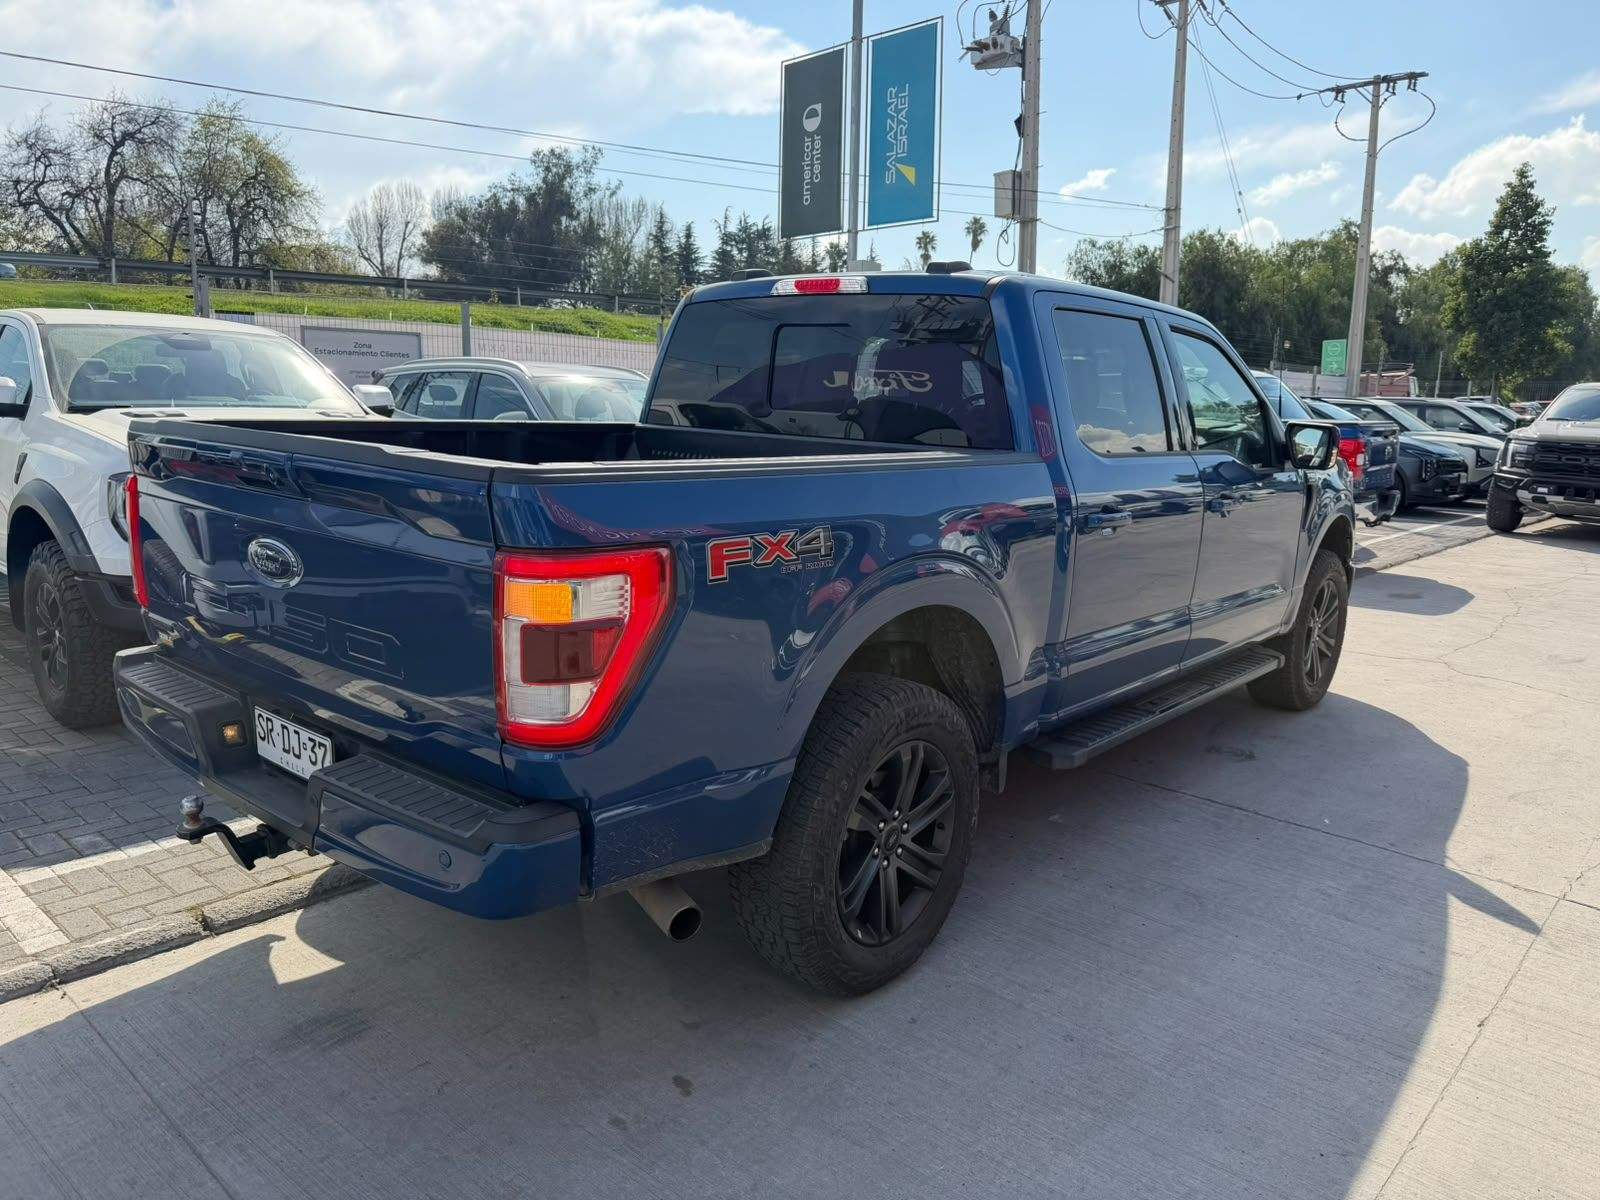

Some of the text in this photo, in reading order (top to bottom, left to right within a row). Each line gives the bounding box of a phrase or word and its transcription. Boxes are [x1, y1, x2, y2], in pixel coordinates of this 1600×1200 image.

[885, 86, 898, 184] SALAZAR
[897, 83, 909, 157] ISRAEL
[803, 136, 812, 206] americar
[813, 134, 822, 183] center
[314, 347, 410, 359] Estacionamiento Clientes
[705, 525, 834, 584] FX4
